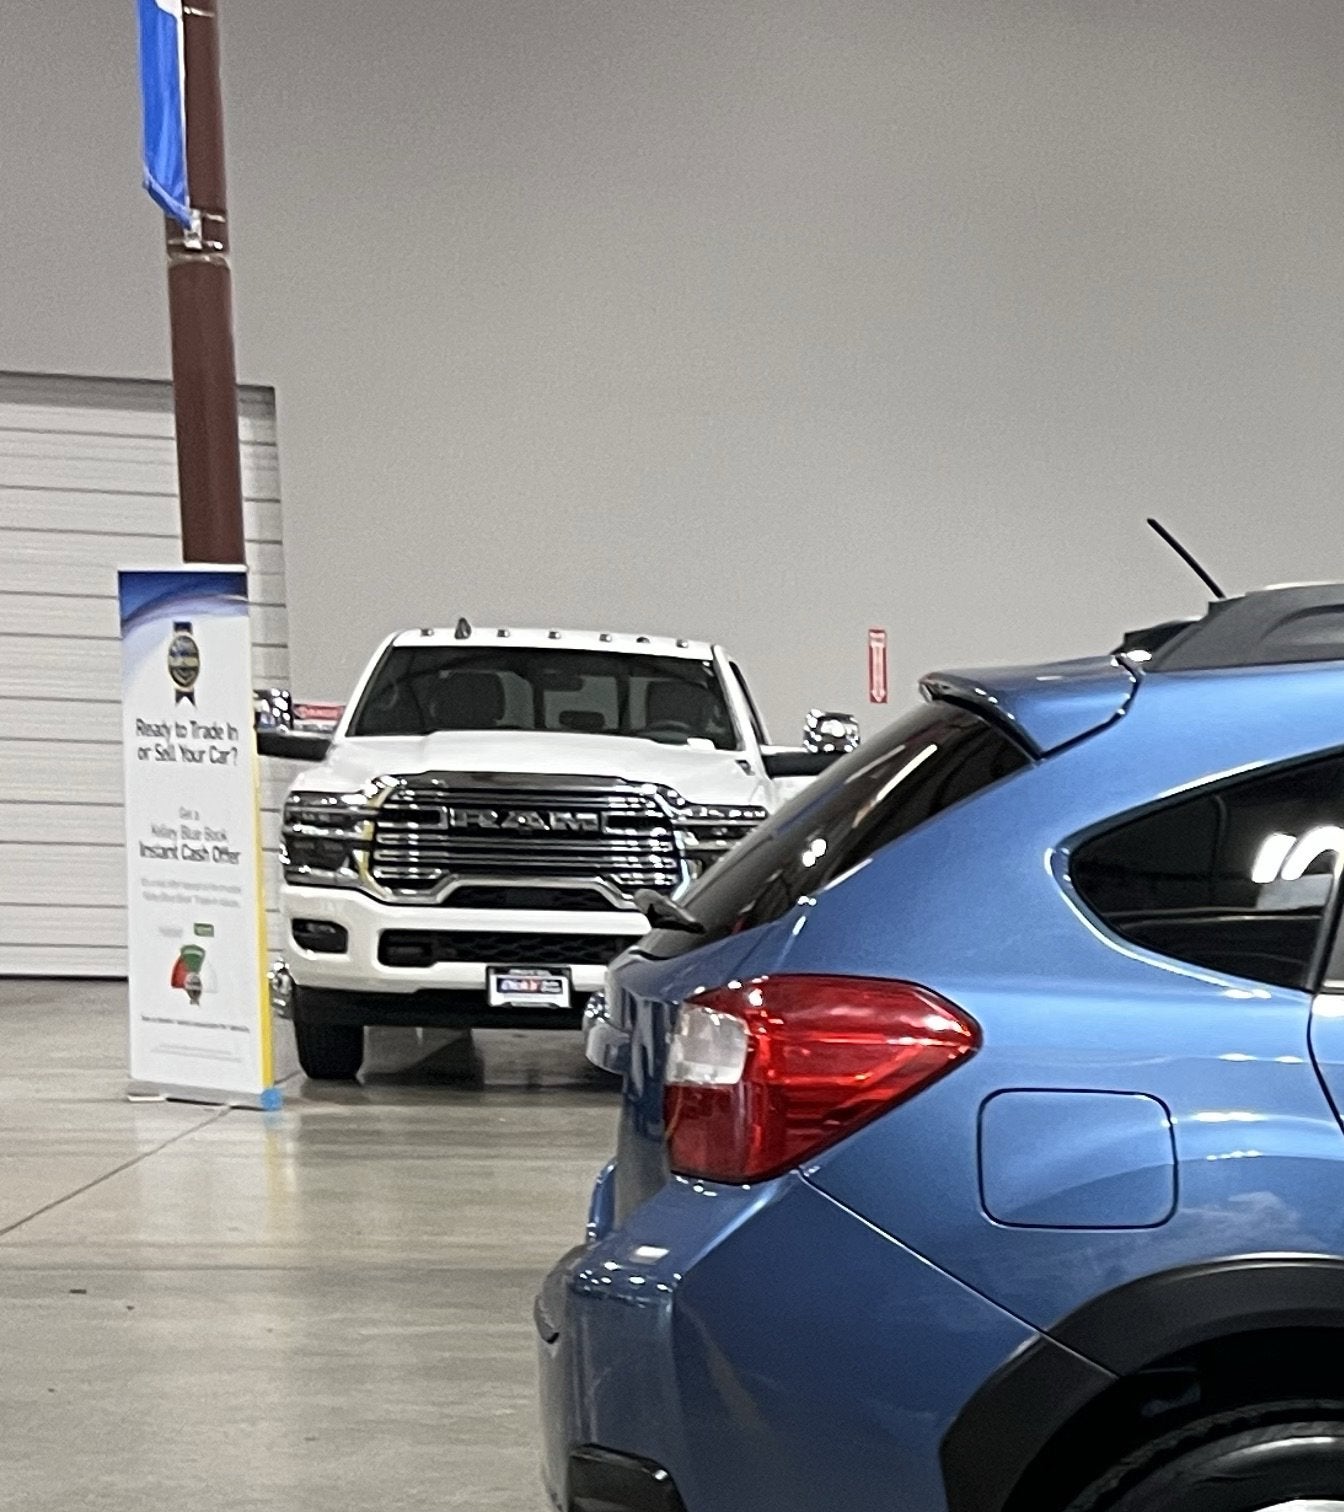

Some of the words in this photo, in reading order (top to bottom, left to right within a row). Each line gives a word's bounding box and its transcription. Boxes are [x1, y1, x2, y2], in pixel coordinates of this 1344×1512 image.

[136, 718, 171, 743] Ready
[175, 721, 187, 738] to
[190, 720, 224, 740] Trade
[138, 746, 151, 760] or
[155, 743, 176, 761] Sell
[178, 744, 206, 763] Your
[209, 745, 238, 766] Car?
[449, 808, 599, 832] RAM
[181, 843, 209, 862] Cash
